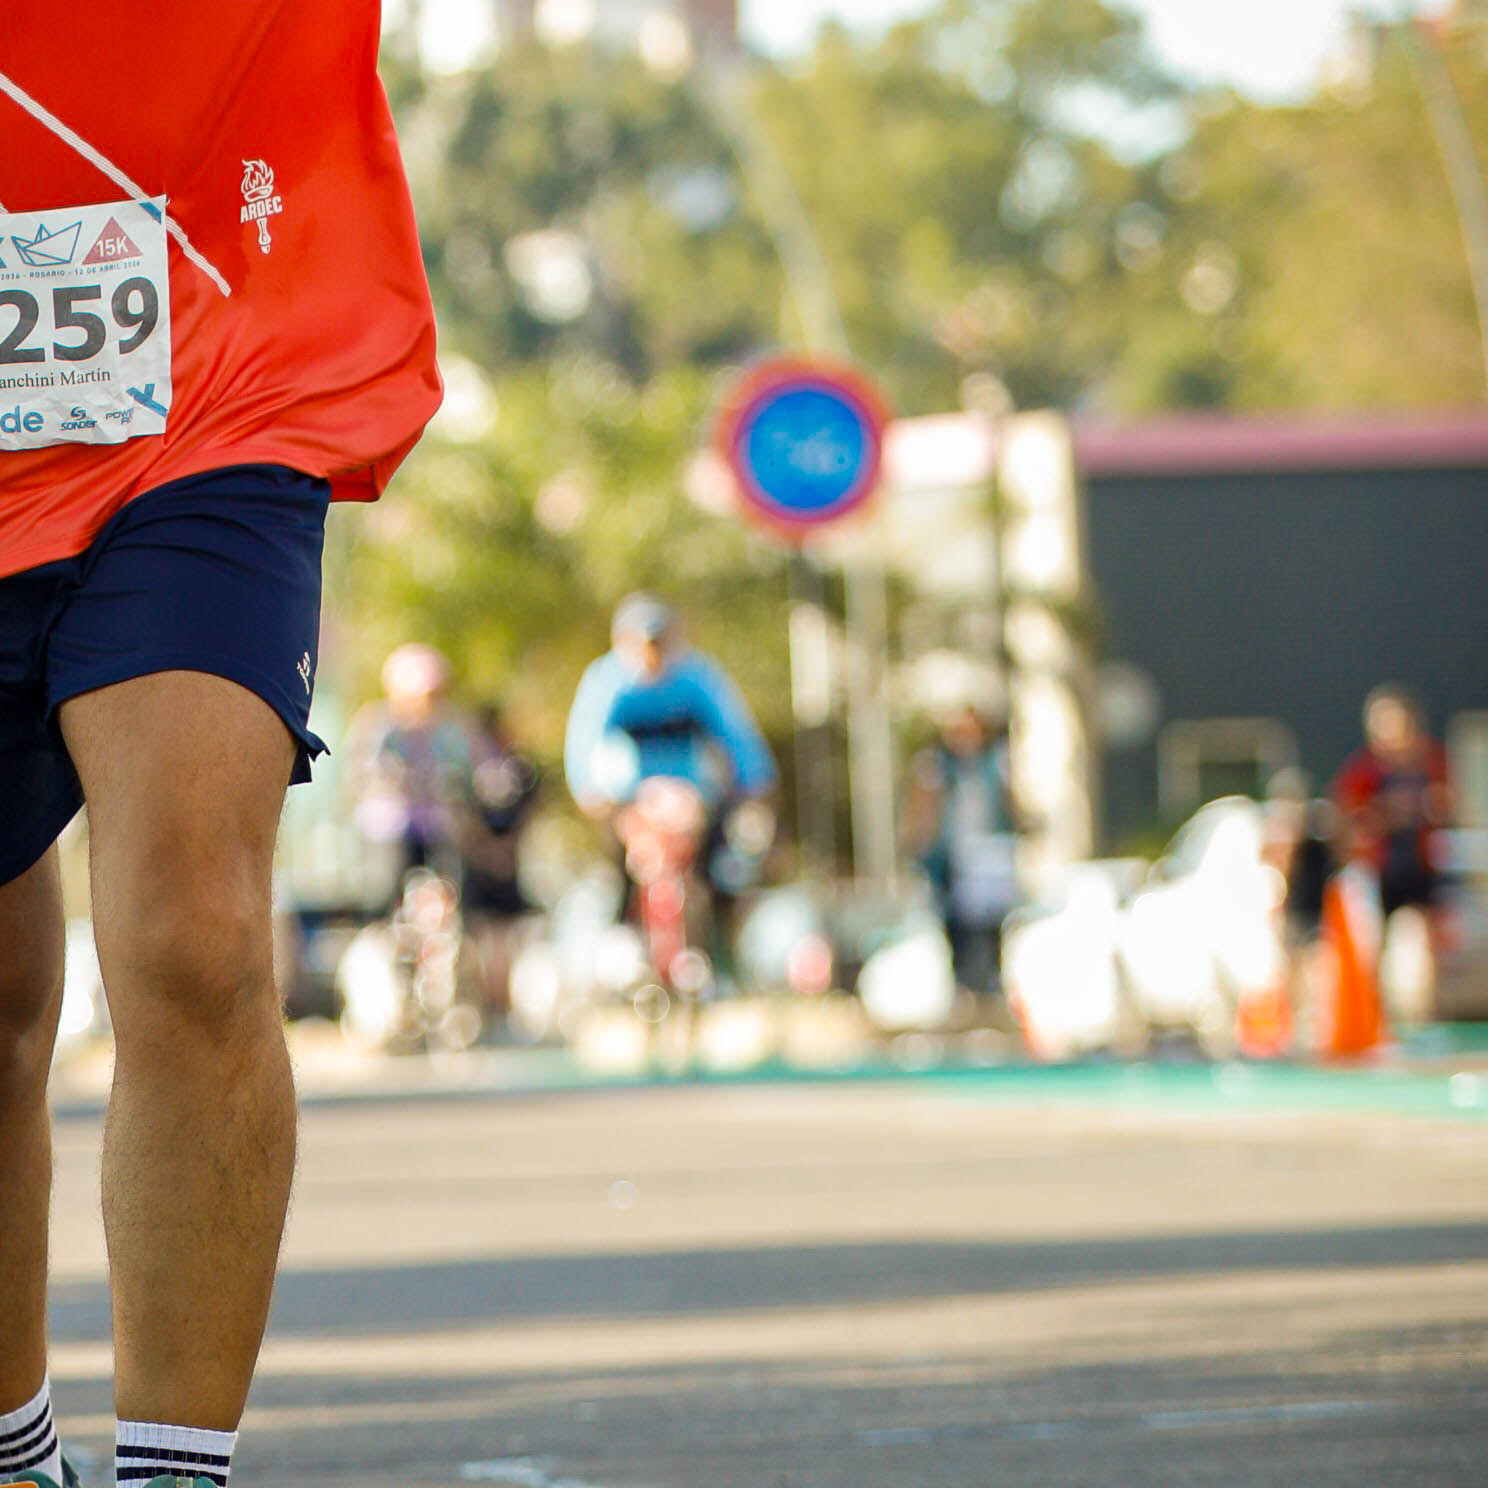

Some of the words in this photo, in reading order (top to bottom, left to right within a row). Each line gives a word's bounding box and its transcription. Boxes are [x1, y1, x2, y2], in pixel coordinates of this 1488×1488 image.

[240, 195, 283, 224] ARDEC
[96, 236, 130, 258] 15K
[29, 269, 66, 279] ROSARIO
[60, 367, 112, 387] Martín
